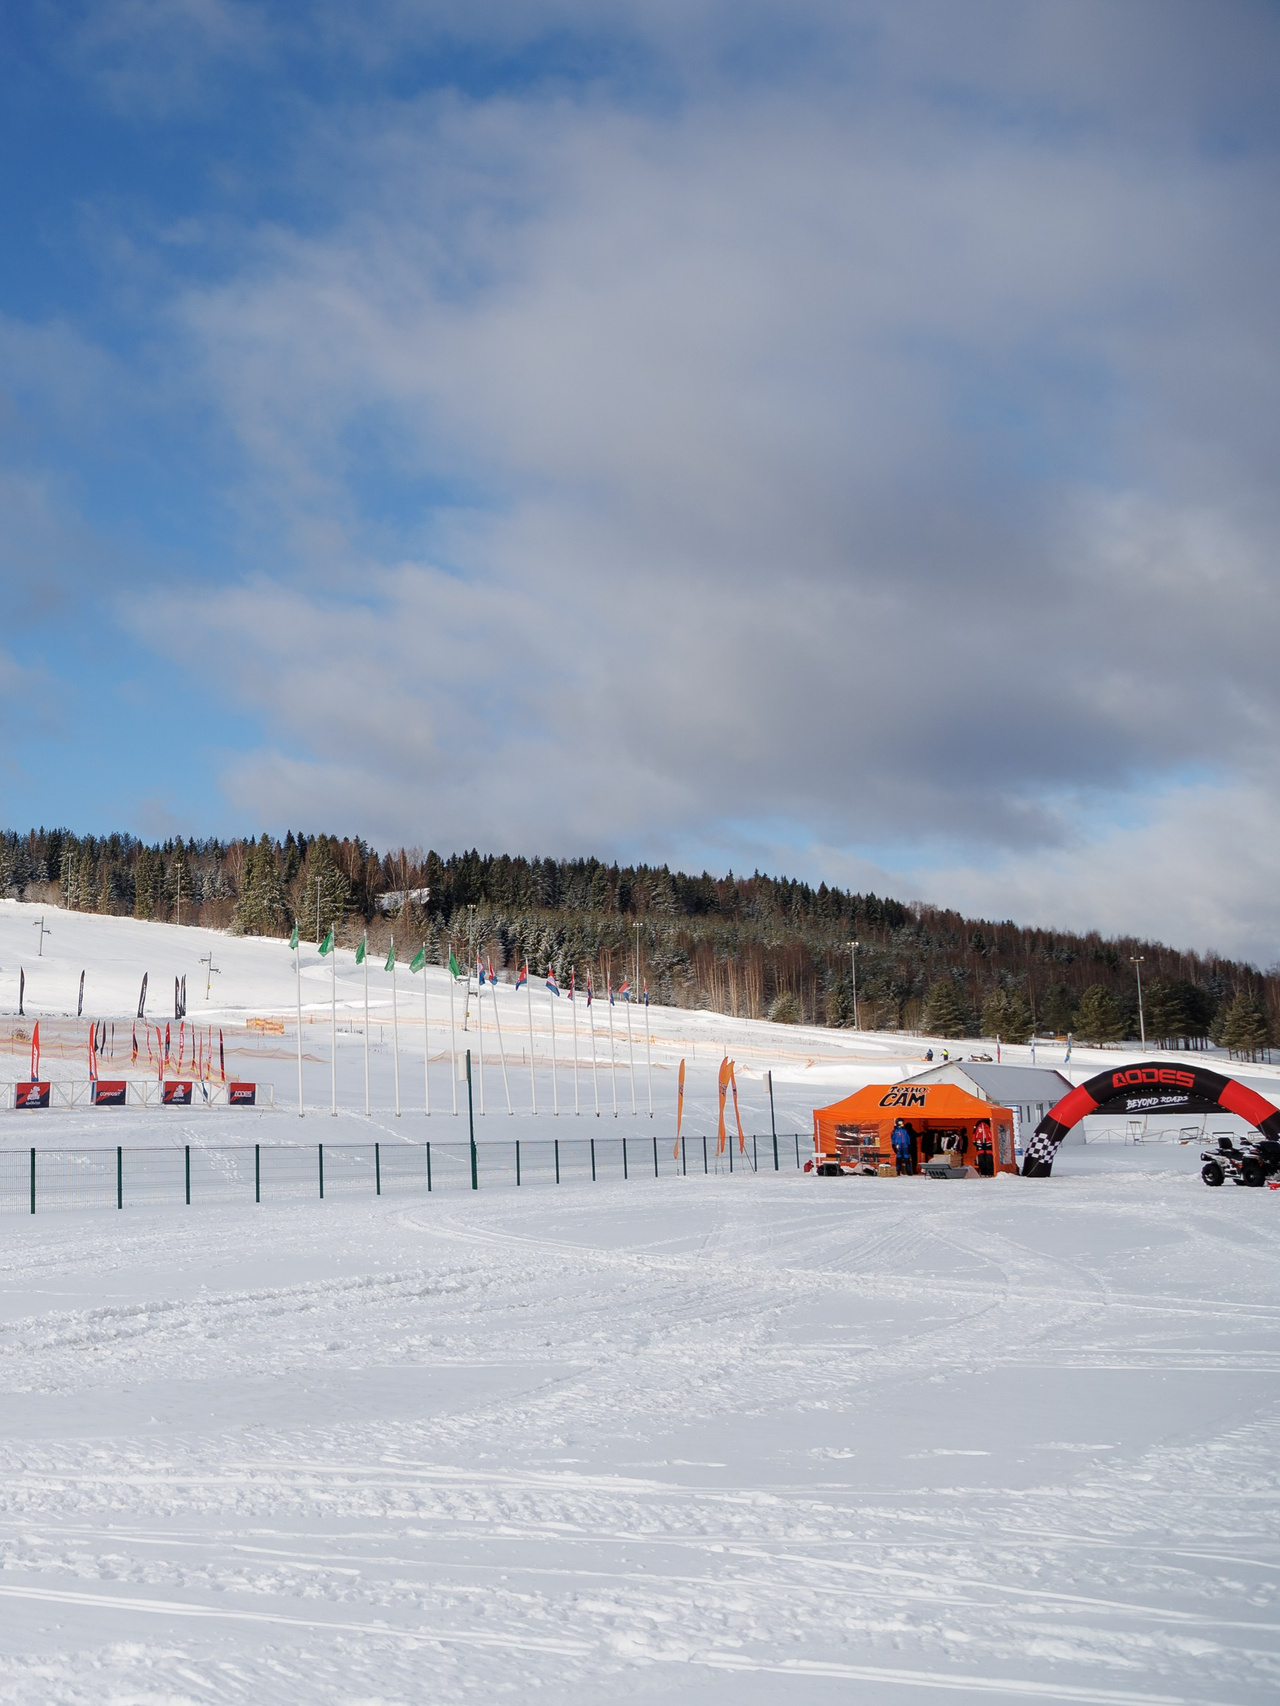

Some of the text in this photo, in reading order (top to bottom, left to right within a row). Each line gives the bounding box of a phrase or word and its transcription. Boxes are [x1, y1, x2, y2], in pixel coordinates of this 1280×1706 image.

[1112, 1068, 1196, 1088] AODES
[879, 1092, 927, 1107] САМ
[1125, 1095, 1189, 1110] BEYOND ROADS
